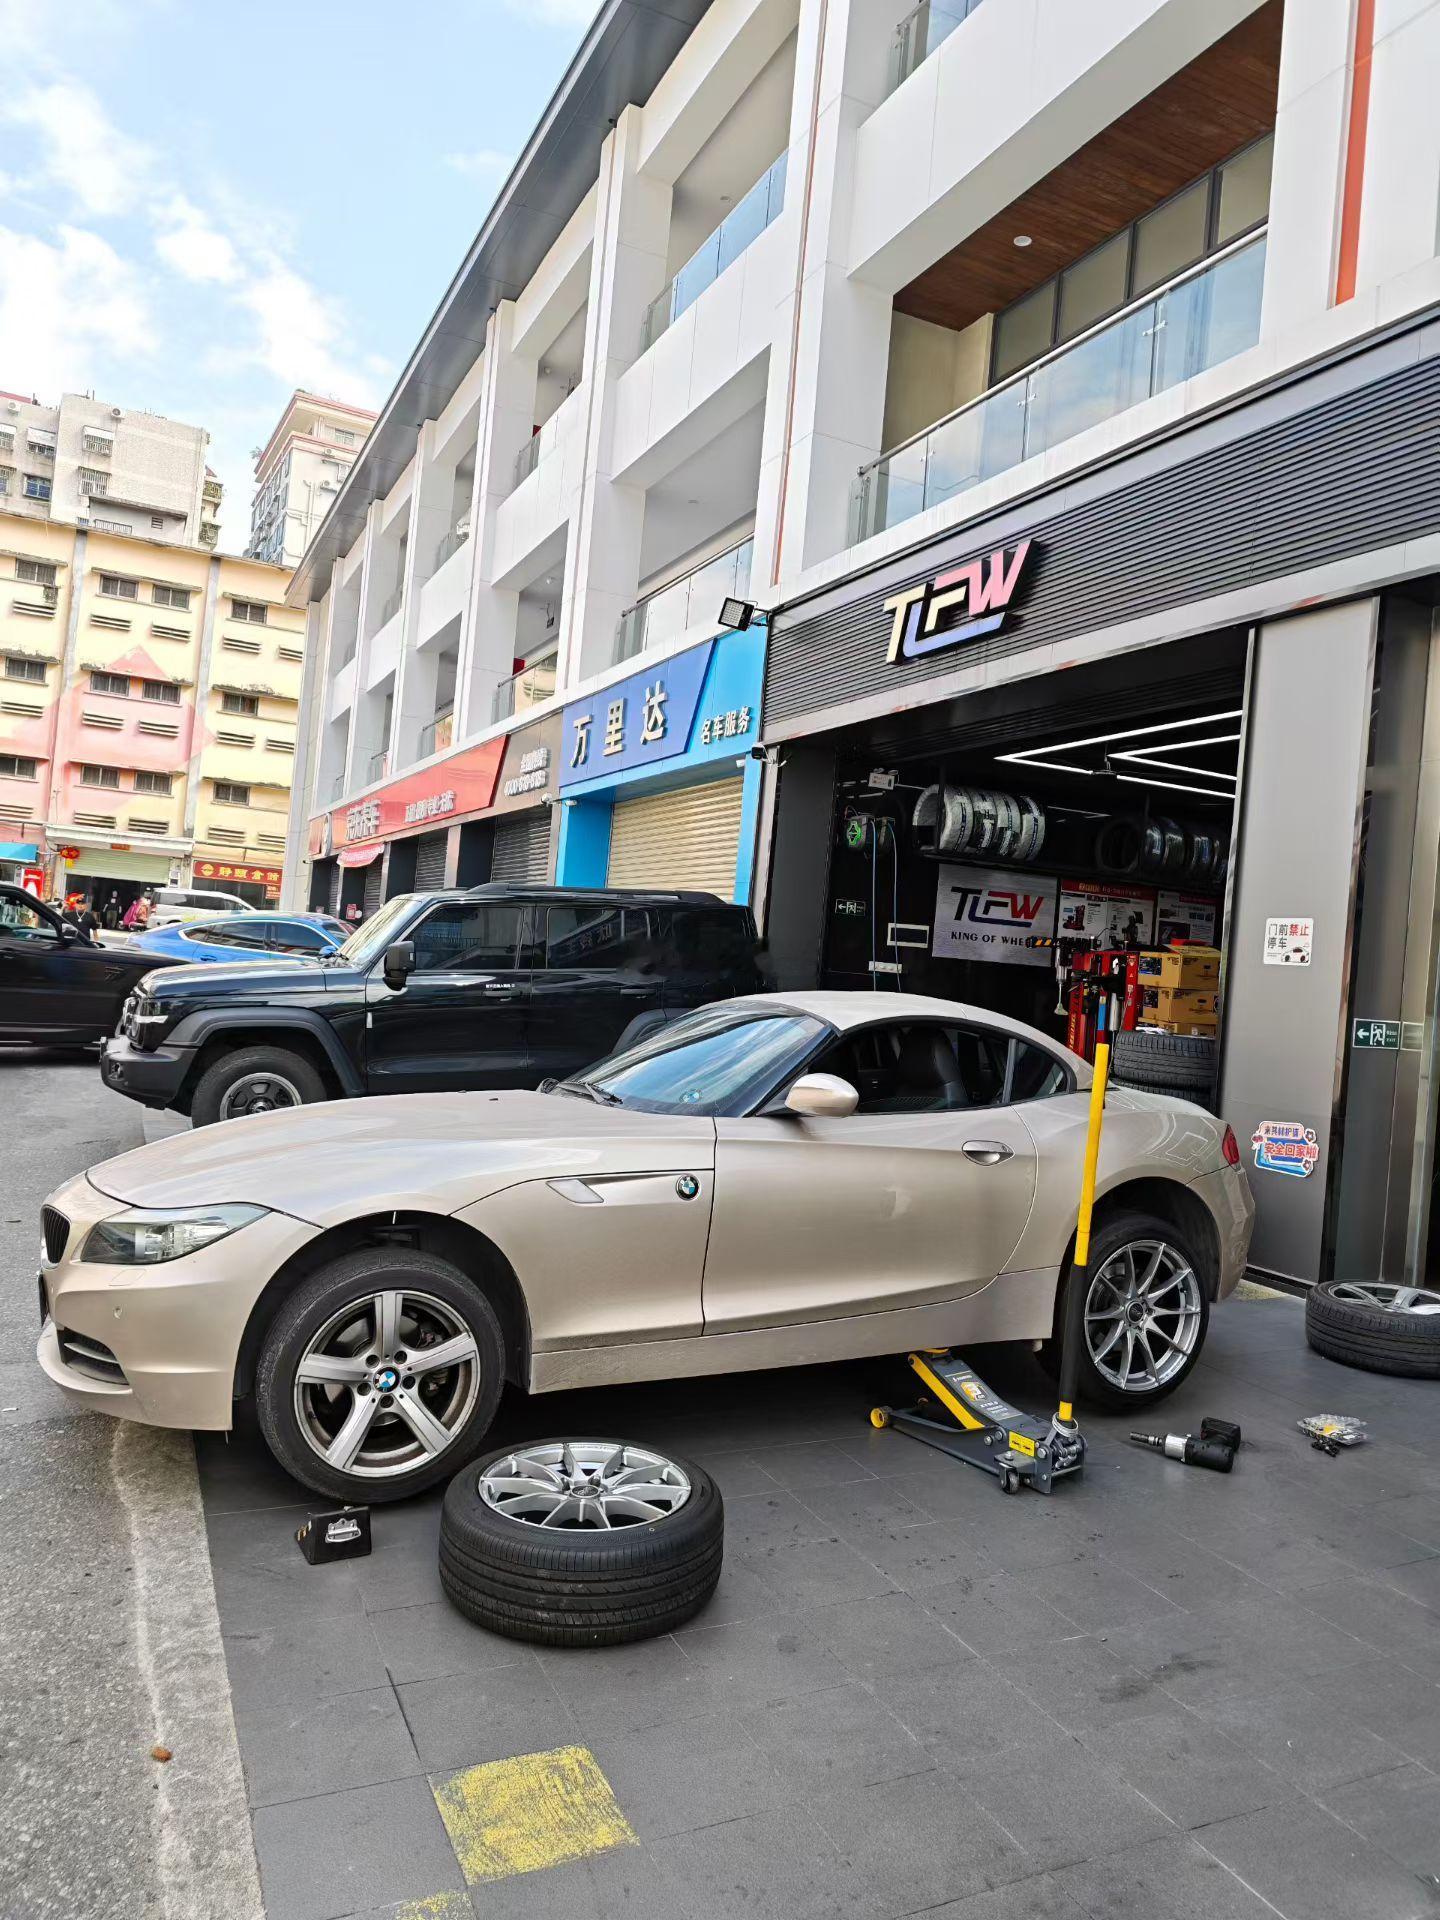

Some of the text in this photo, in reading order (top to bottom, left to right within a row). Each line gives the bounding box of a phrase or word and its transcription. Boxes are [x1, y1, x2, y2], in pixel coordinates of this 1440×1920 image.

[569, 680, 670, 767] 万里达
[701, 706, 752, 745] 名车服务
[1268, 923, 1309, 936] 门前禁止
[950, 931, 1026, 946] KING OF WHE
[1267, 936, 1288, 949] 停车
[1264, 1142, 1317, 1159] 安全回家啦
